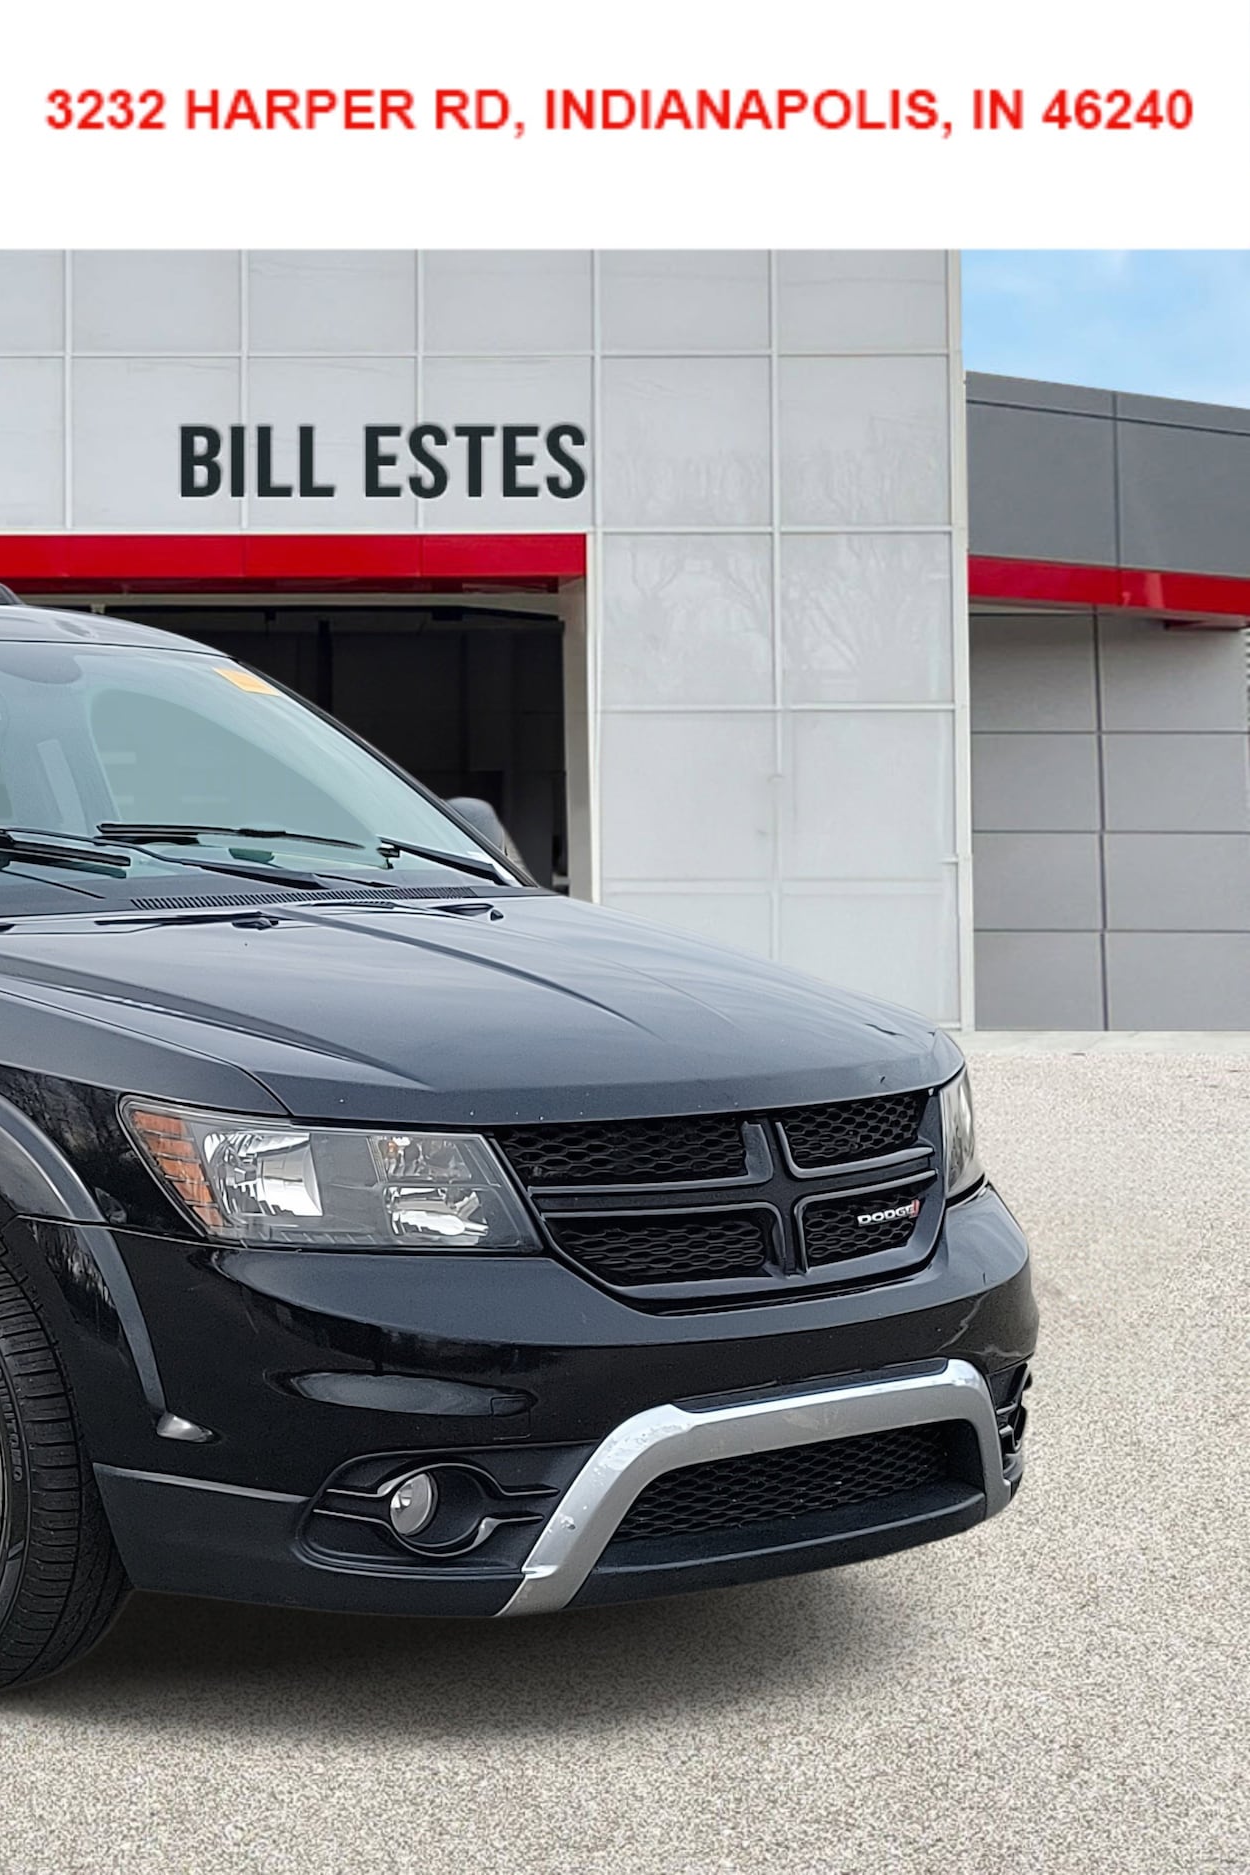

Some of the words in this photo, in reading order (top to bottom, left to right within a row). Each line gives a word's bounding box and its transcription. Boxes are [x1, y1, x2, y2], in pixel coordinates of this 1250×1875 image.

[180, 425, 334, 498] BILL
[365, 425, 586, 498] ESTES
[857, 1203, 915, 1225] DODGE
